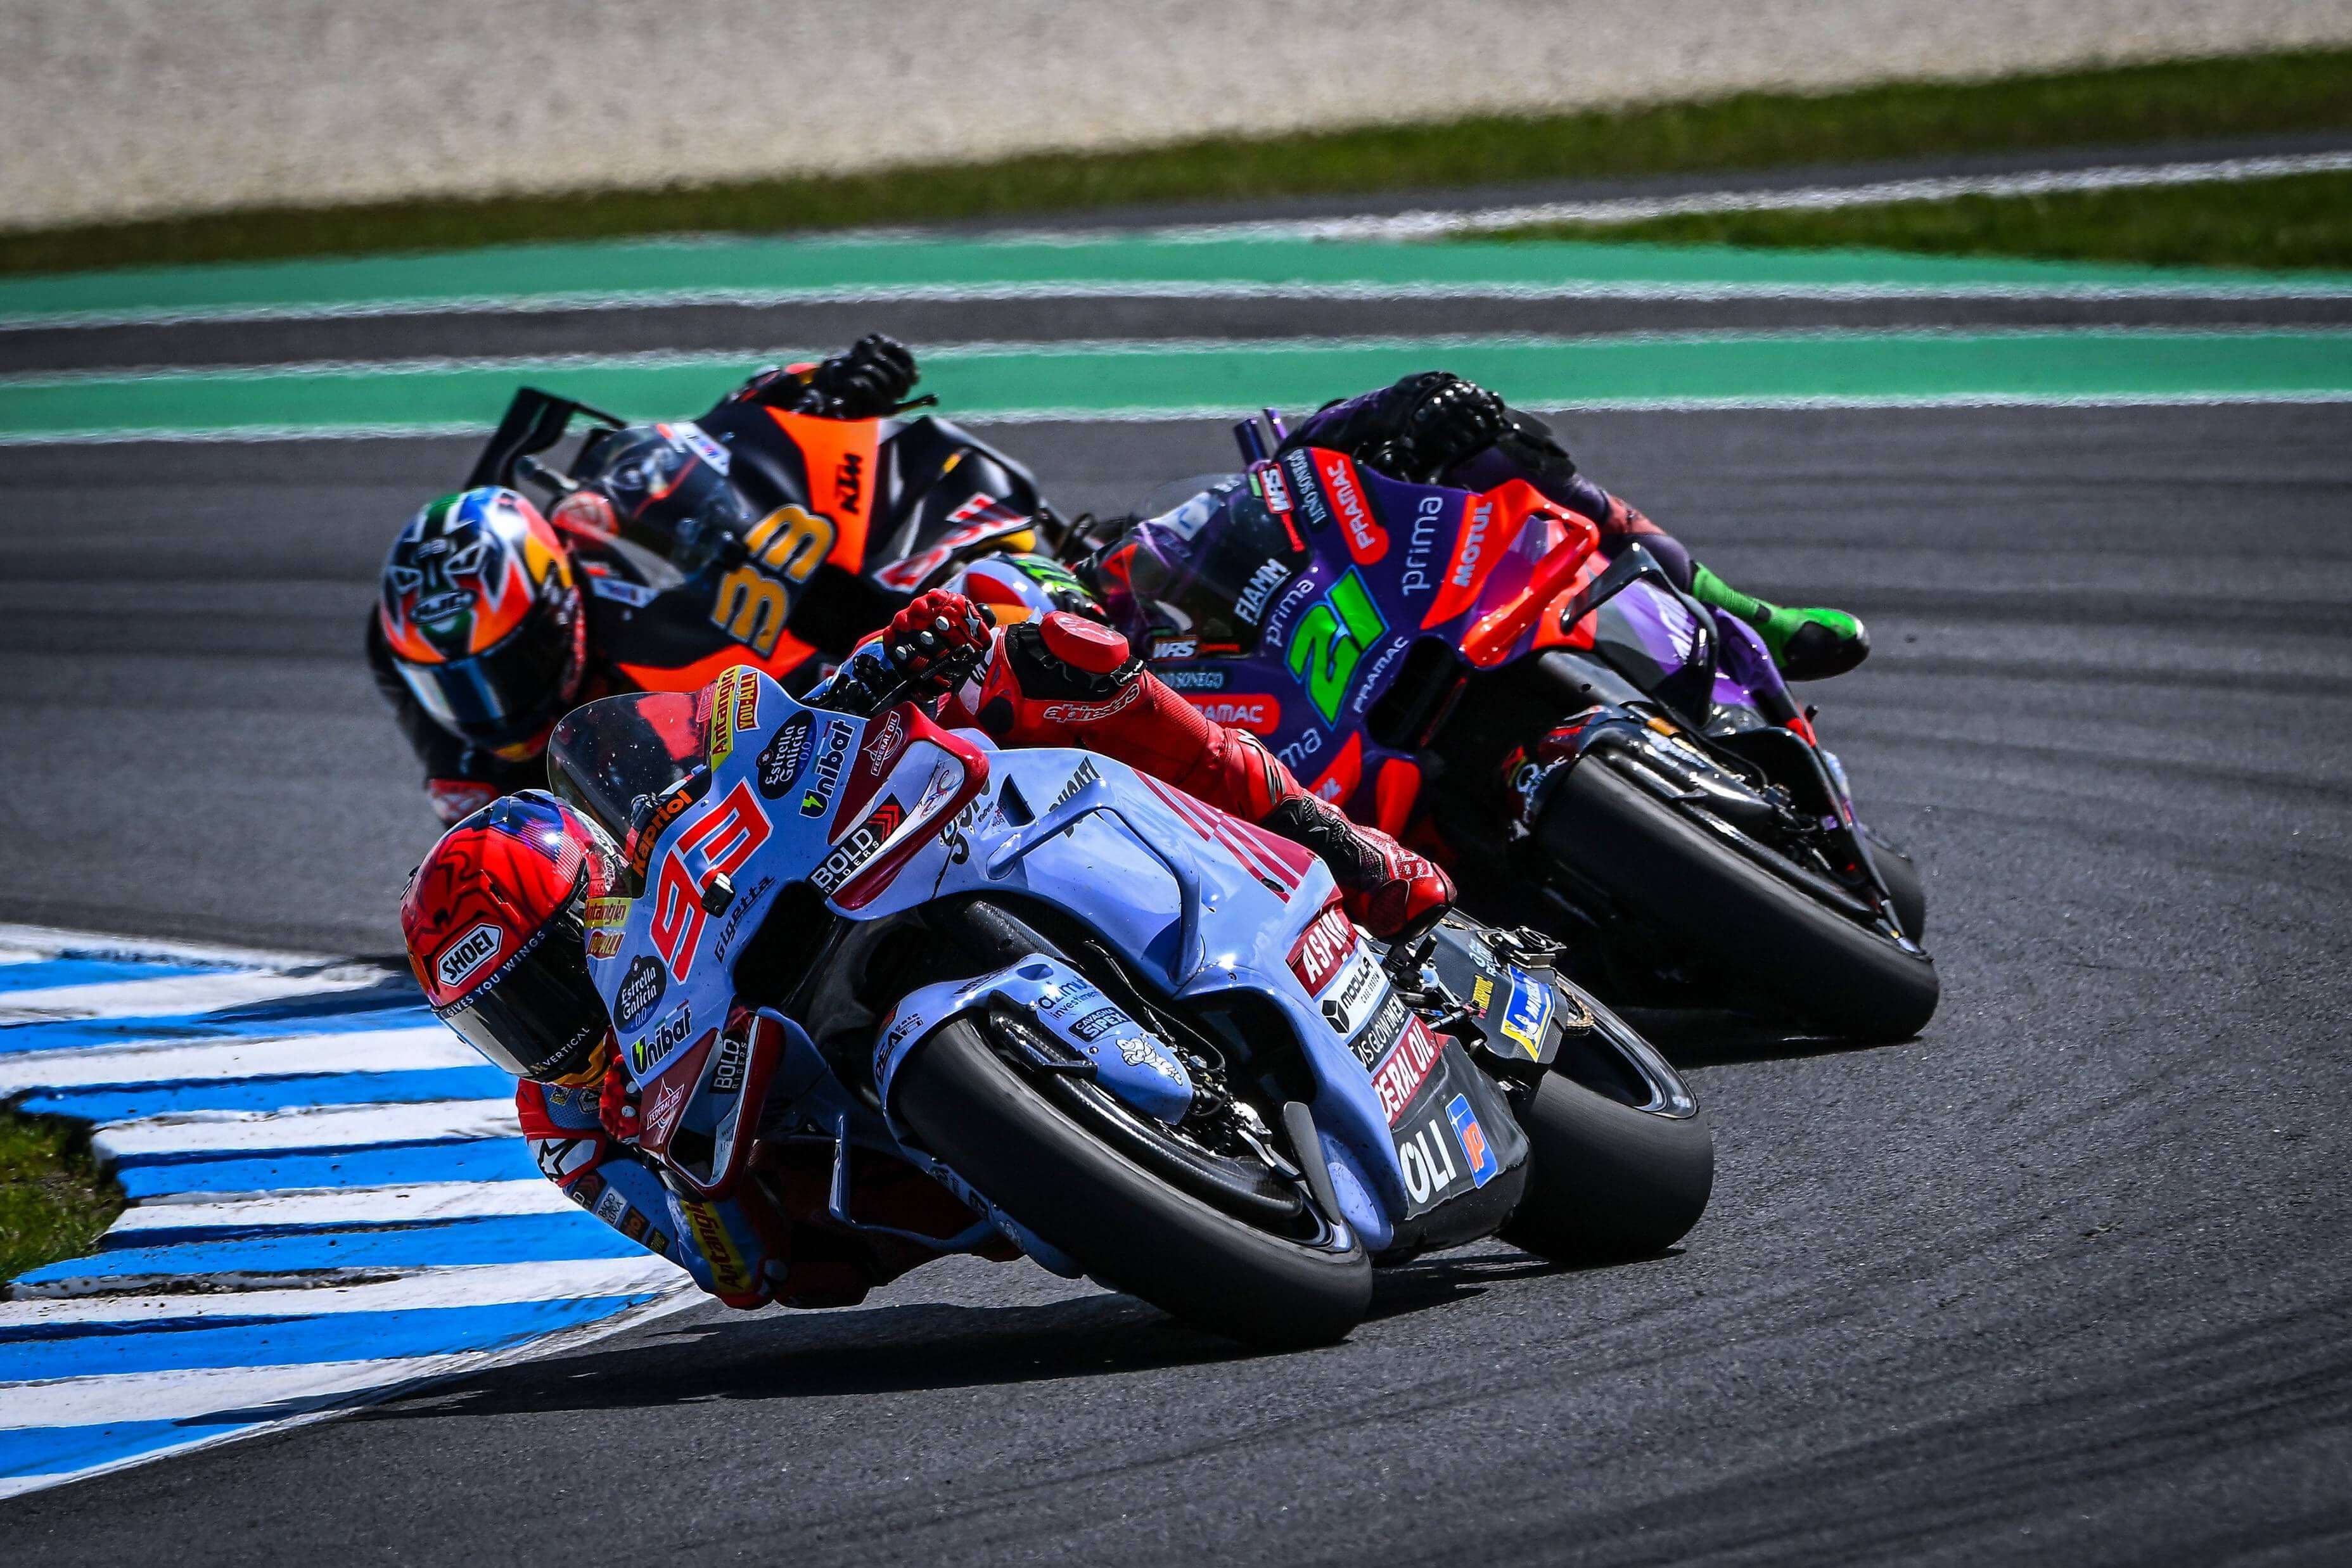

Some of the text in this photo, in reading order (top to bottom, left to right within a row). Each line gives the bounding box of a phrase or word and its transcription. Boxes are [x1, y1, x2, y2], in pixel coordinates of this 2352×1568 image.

[835, 454, 864, 514] KTM
[1262, 469, 1290, 511] WRS
[1326, 459, 1376, 549] PRAMAC
[1402, 497, 1443, 596] prima
[1452, 502, 1493, 587] MOTUL
[709, 502, 836, 656] 33
[1234, 559, 1290, 625] FIAMM
[1267, 578, 1315, 647] prima
[1153, 639, 1198, 659] WRS
[1284, 564, 1390, 730] 21
[1353, 635, 1409, 713] PRAMAC
[765, 725, 795, 786] Estrella
[779, 725, 807, 782] Galicia
[800, 719, 855, 819] Unibat
[872, 716, 898, 774] FEDERAL OIL
[632, 789, 693, 877] Kapriol
[810, 828, 874, 889] BOLD
[649, 776, 774, 985] 93
[824, 840, 880, 895] RIDERS
[442, 929, 495, 981] SHOEI
[446, 930, 546, 1017] GIVES YOU WINGS
[1340, 957, 1374, 1009] MODULA
[622, 966, 656, 1005] Estrella
[623, 984, 658, 1020] Galicia
[542, 1026, 591, 1068] VERTICAL
[631, 1007, 692, 1075] Unibat
[1076, 1007, 1115, 1031] CAVAGNA
[1083, 1012, 1128, 1038] SIPEX
[1367, 1010, 1393, 1053] GLOW
[1408, 1021, 1435, 1072] OIL
[713, 1038, 739, 1089] BOLD
[732, 1042, 747, 1089] RIDERS
[649, 1093, 680, 1122] FEDERAL OIL
[1399, 1119, 1457, 1205] OLI
[1462, 1121, 1486, 1172] IP
